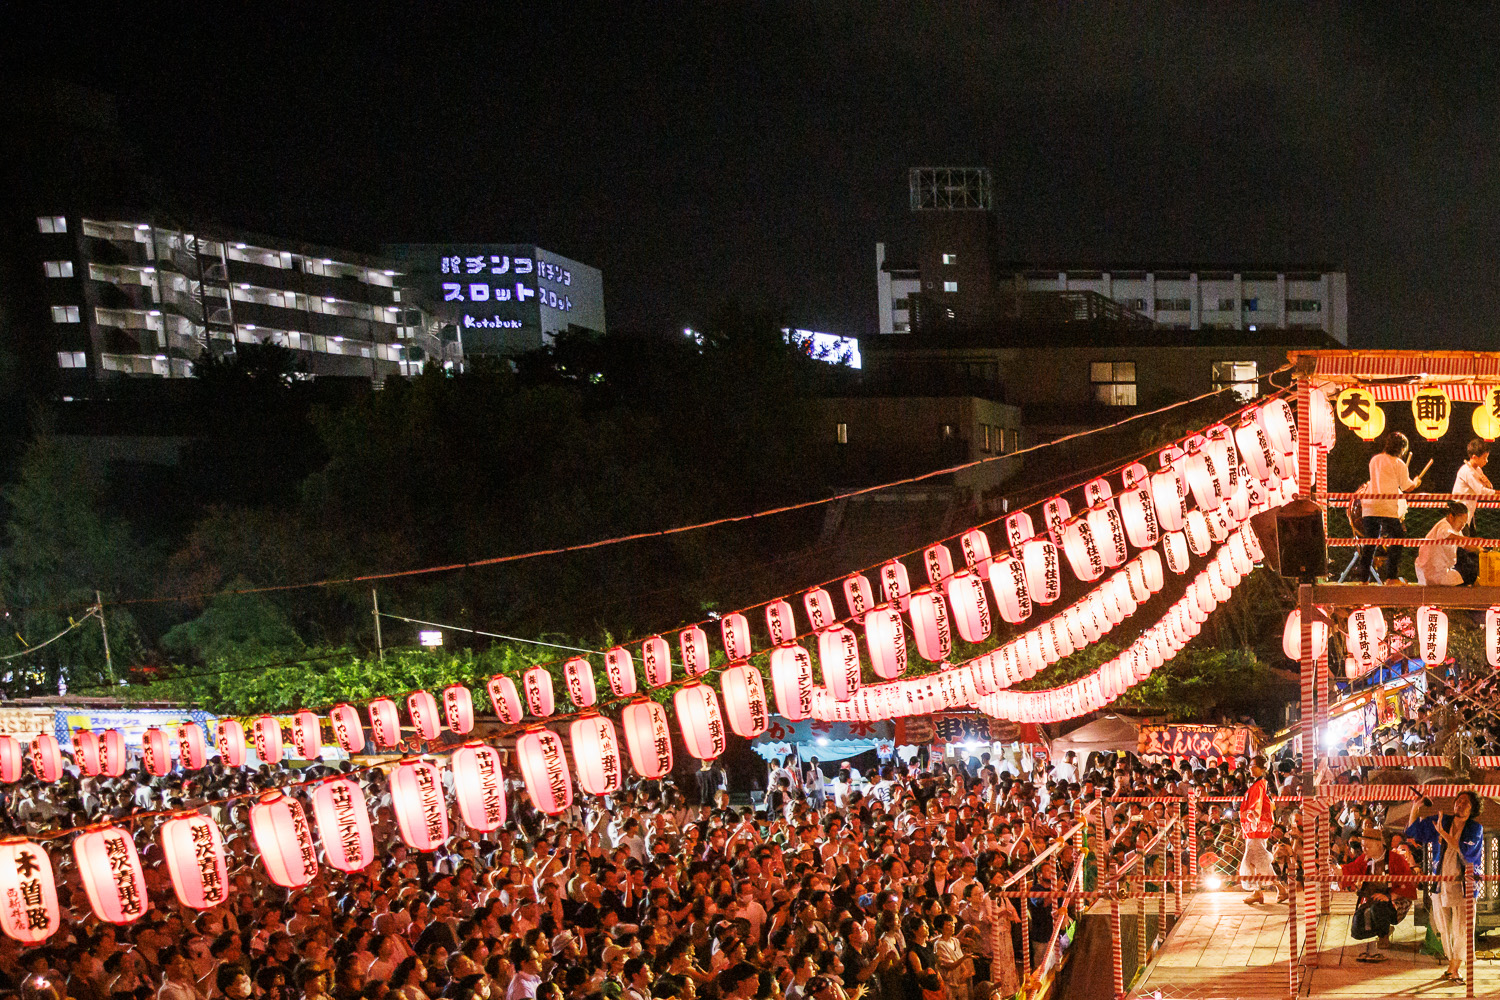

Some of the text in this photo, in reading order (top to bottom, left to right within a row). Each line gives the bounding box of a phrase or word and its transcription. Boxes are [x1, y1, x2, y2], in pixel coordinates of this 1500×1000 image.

[441, 255, 533, 275] パチンコ
[538, 261, 571, 286] パチンコ
[442, 282, 535, 302] スロット
[540, 288, 572, 312] スロット
[464, 315, 523, 329] Kotobuki
[1341, 392, 1370, 422] 大
[1416, 394, 1447, 421] 師
[1355, 612, 1372, 661] 西新井町会
[1427, 613, 1439, 661] 西新井町会
[933, 716, 992, 743] 串焼
